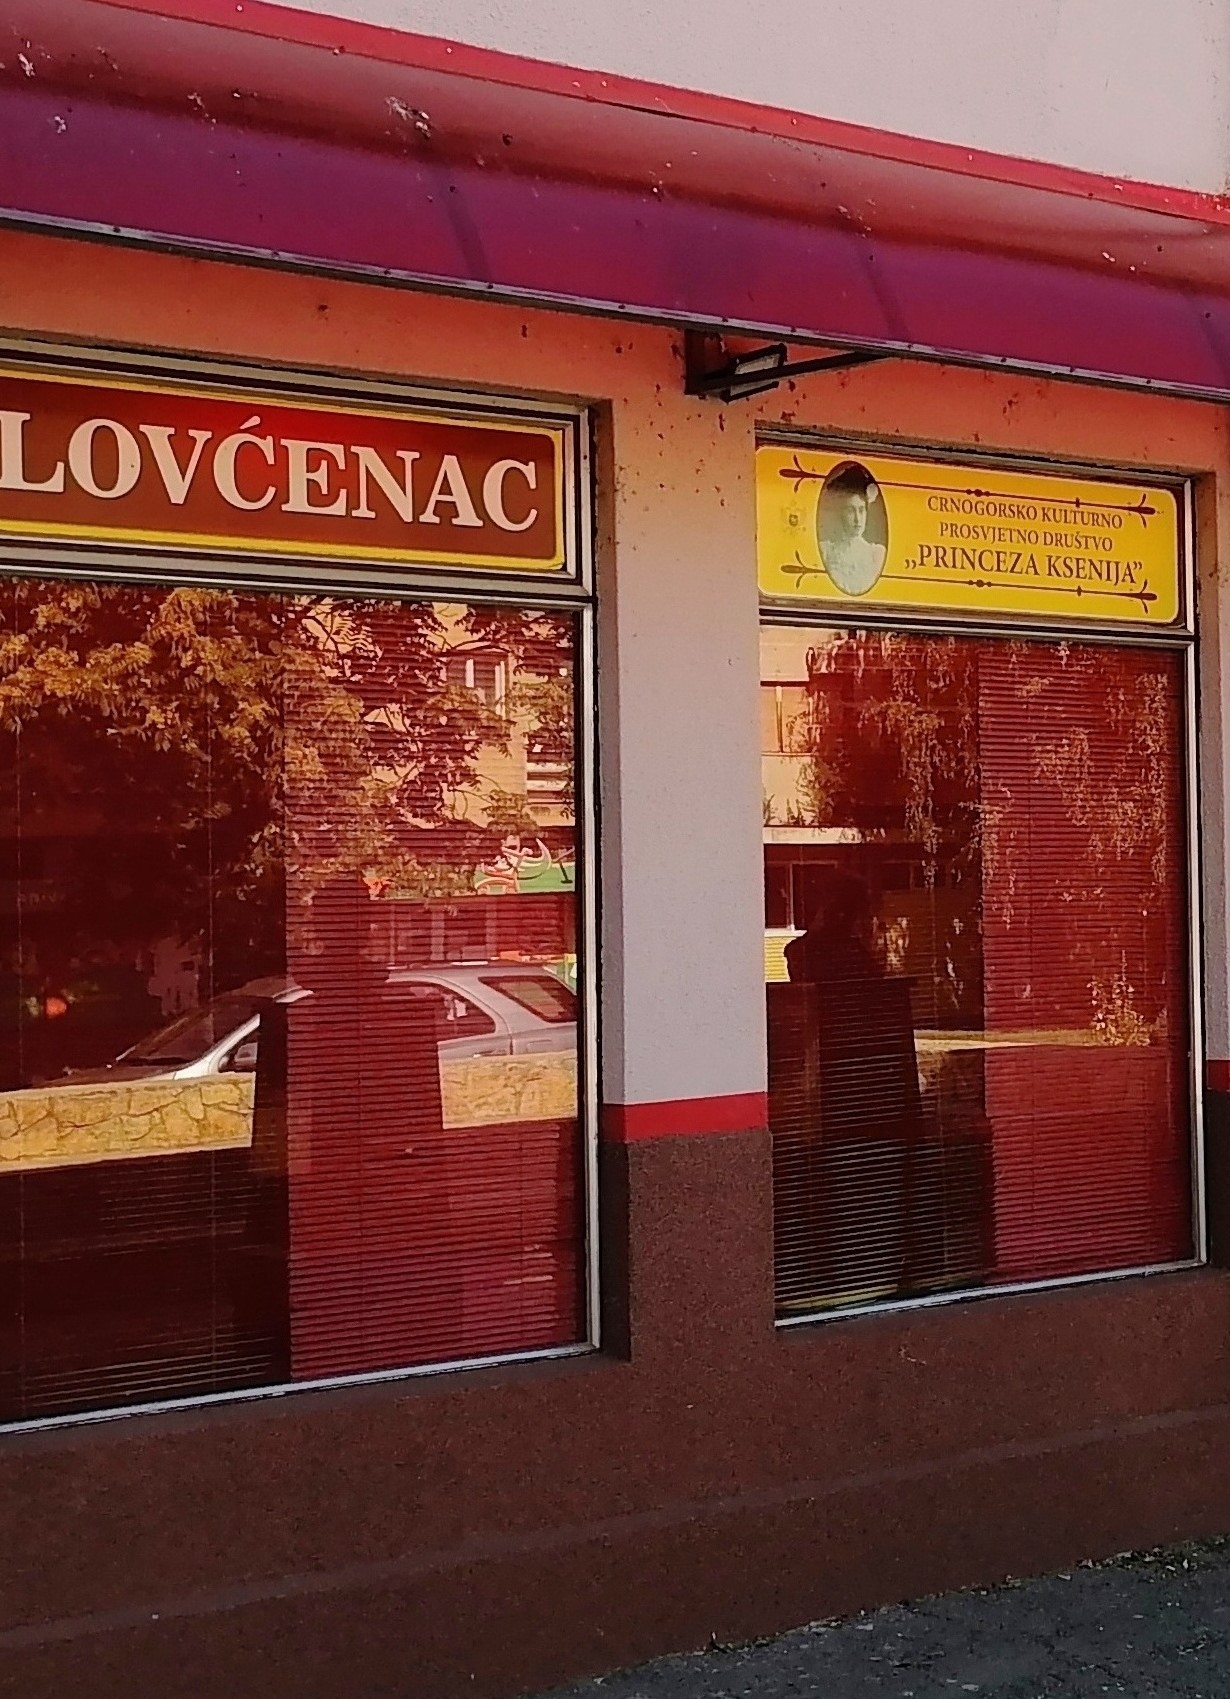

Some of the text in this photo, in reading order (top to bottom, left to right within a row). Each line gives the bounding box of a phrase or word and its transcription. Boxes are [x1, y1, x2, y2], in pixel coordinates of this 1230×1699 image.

[0, 411, 539, 532] LOVĆENAC
[927, 495, 1123, 530] CRNOGORSKO KULTURNO
[939, 521, 1113, 552] PROSVJETNO DRUŠTVO
[904, 543, 1040, 576] „PRINCEZA
